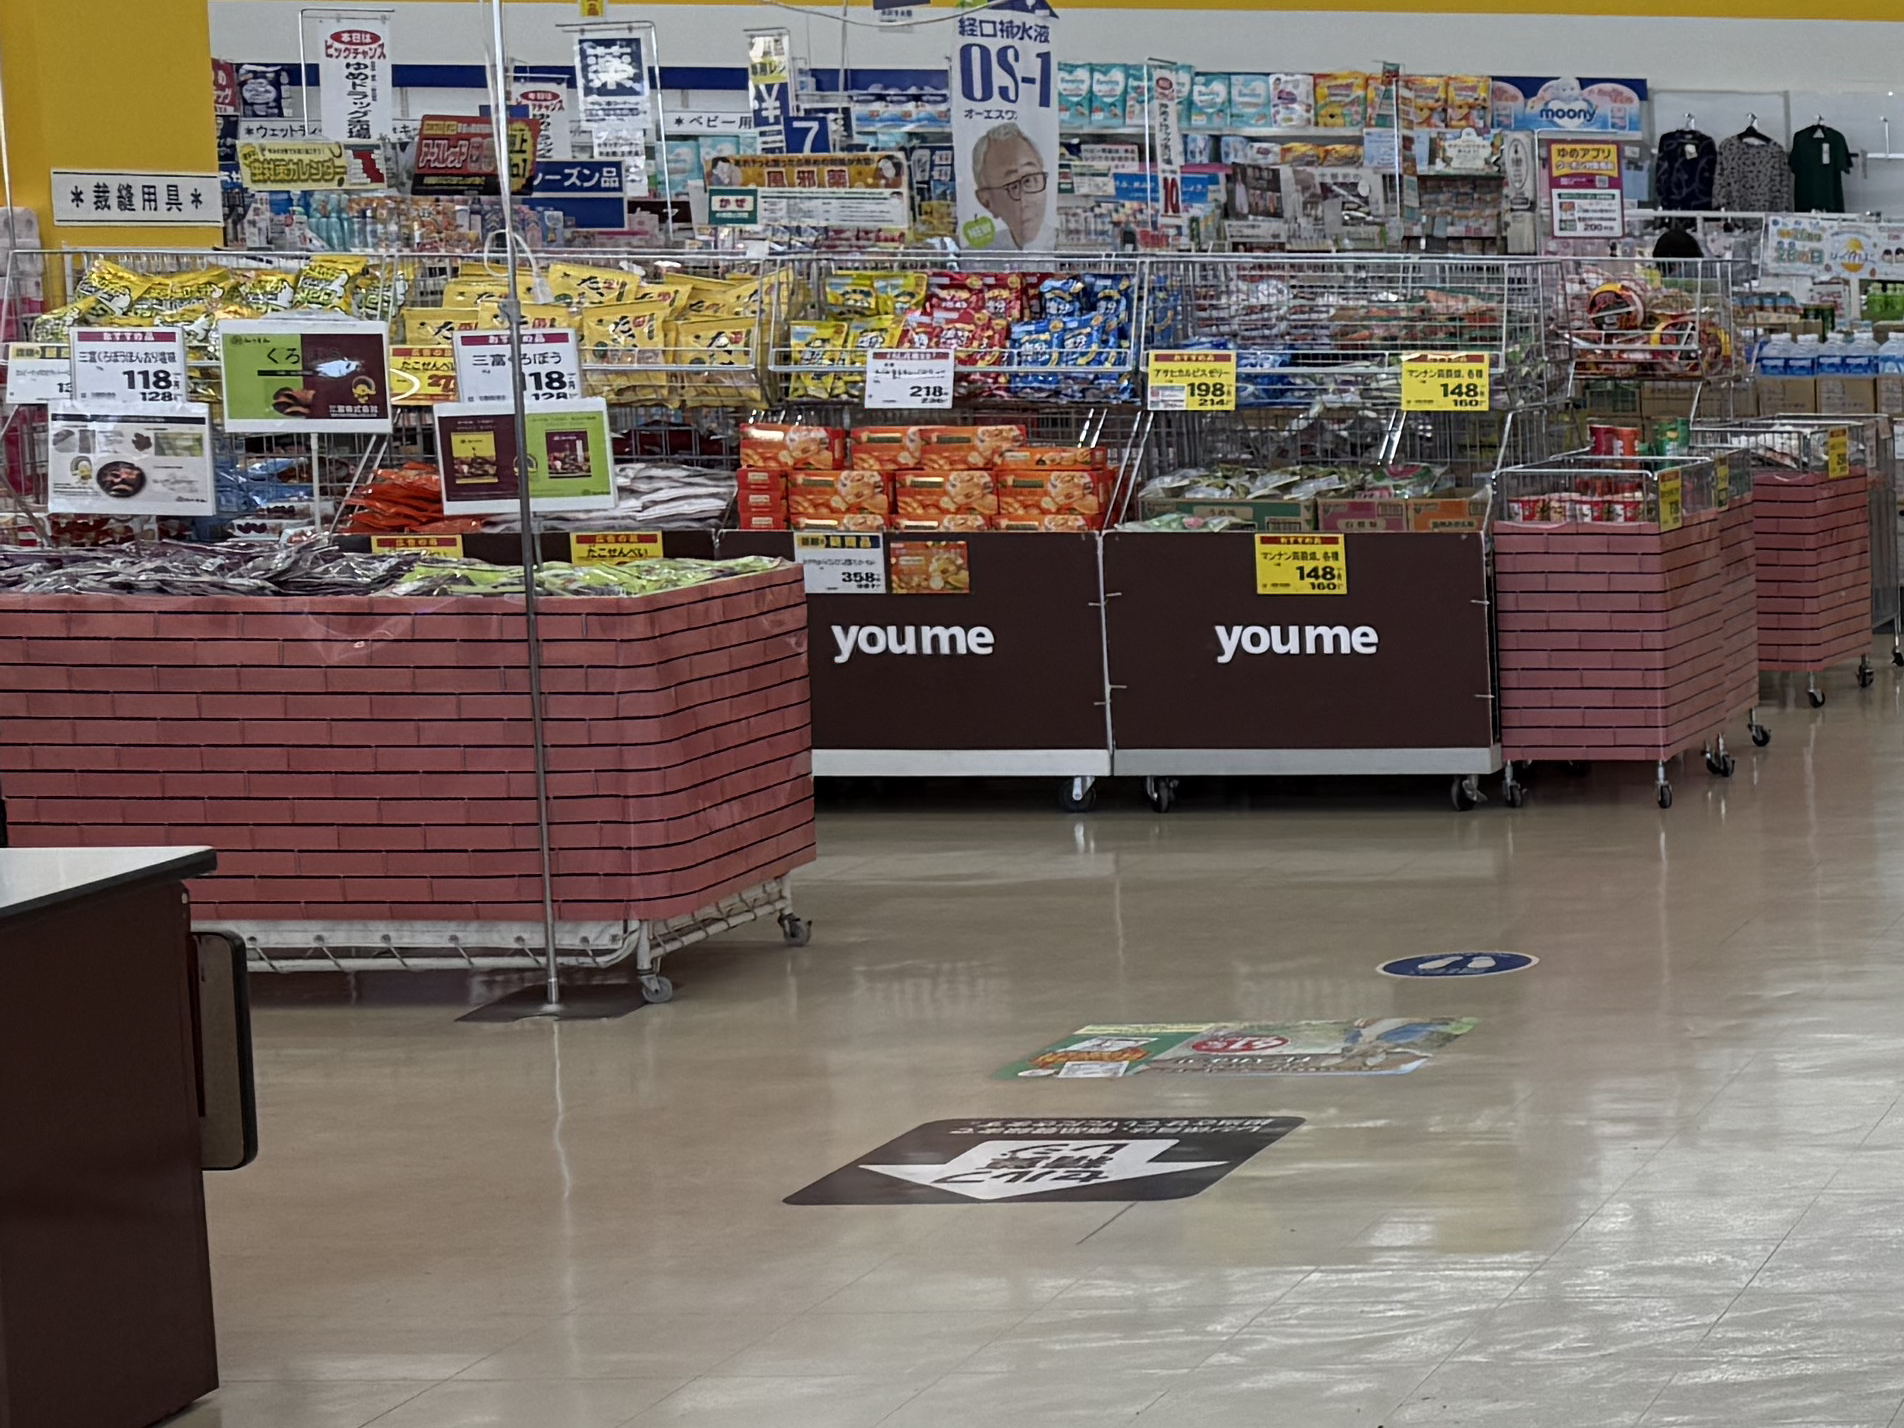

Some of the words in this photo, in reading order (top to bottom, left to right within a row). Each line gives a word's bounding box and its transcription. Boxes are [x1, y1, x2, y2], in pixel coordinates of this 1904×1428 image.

[958, 16, 1051, 45] 経口補水液
[959, 42, 1052, 108] OS-1
[123, 370, 172, 390] 118
[1439, 381, 1482, 398] 148
[1186, 381, 1227, 399] 198
[1294, 565, 1336, 583] 148
